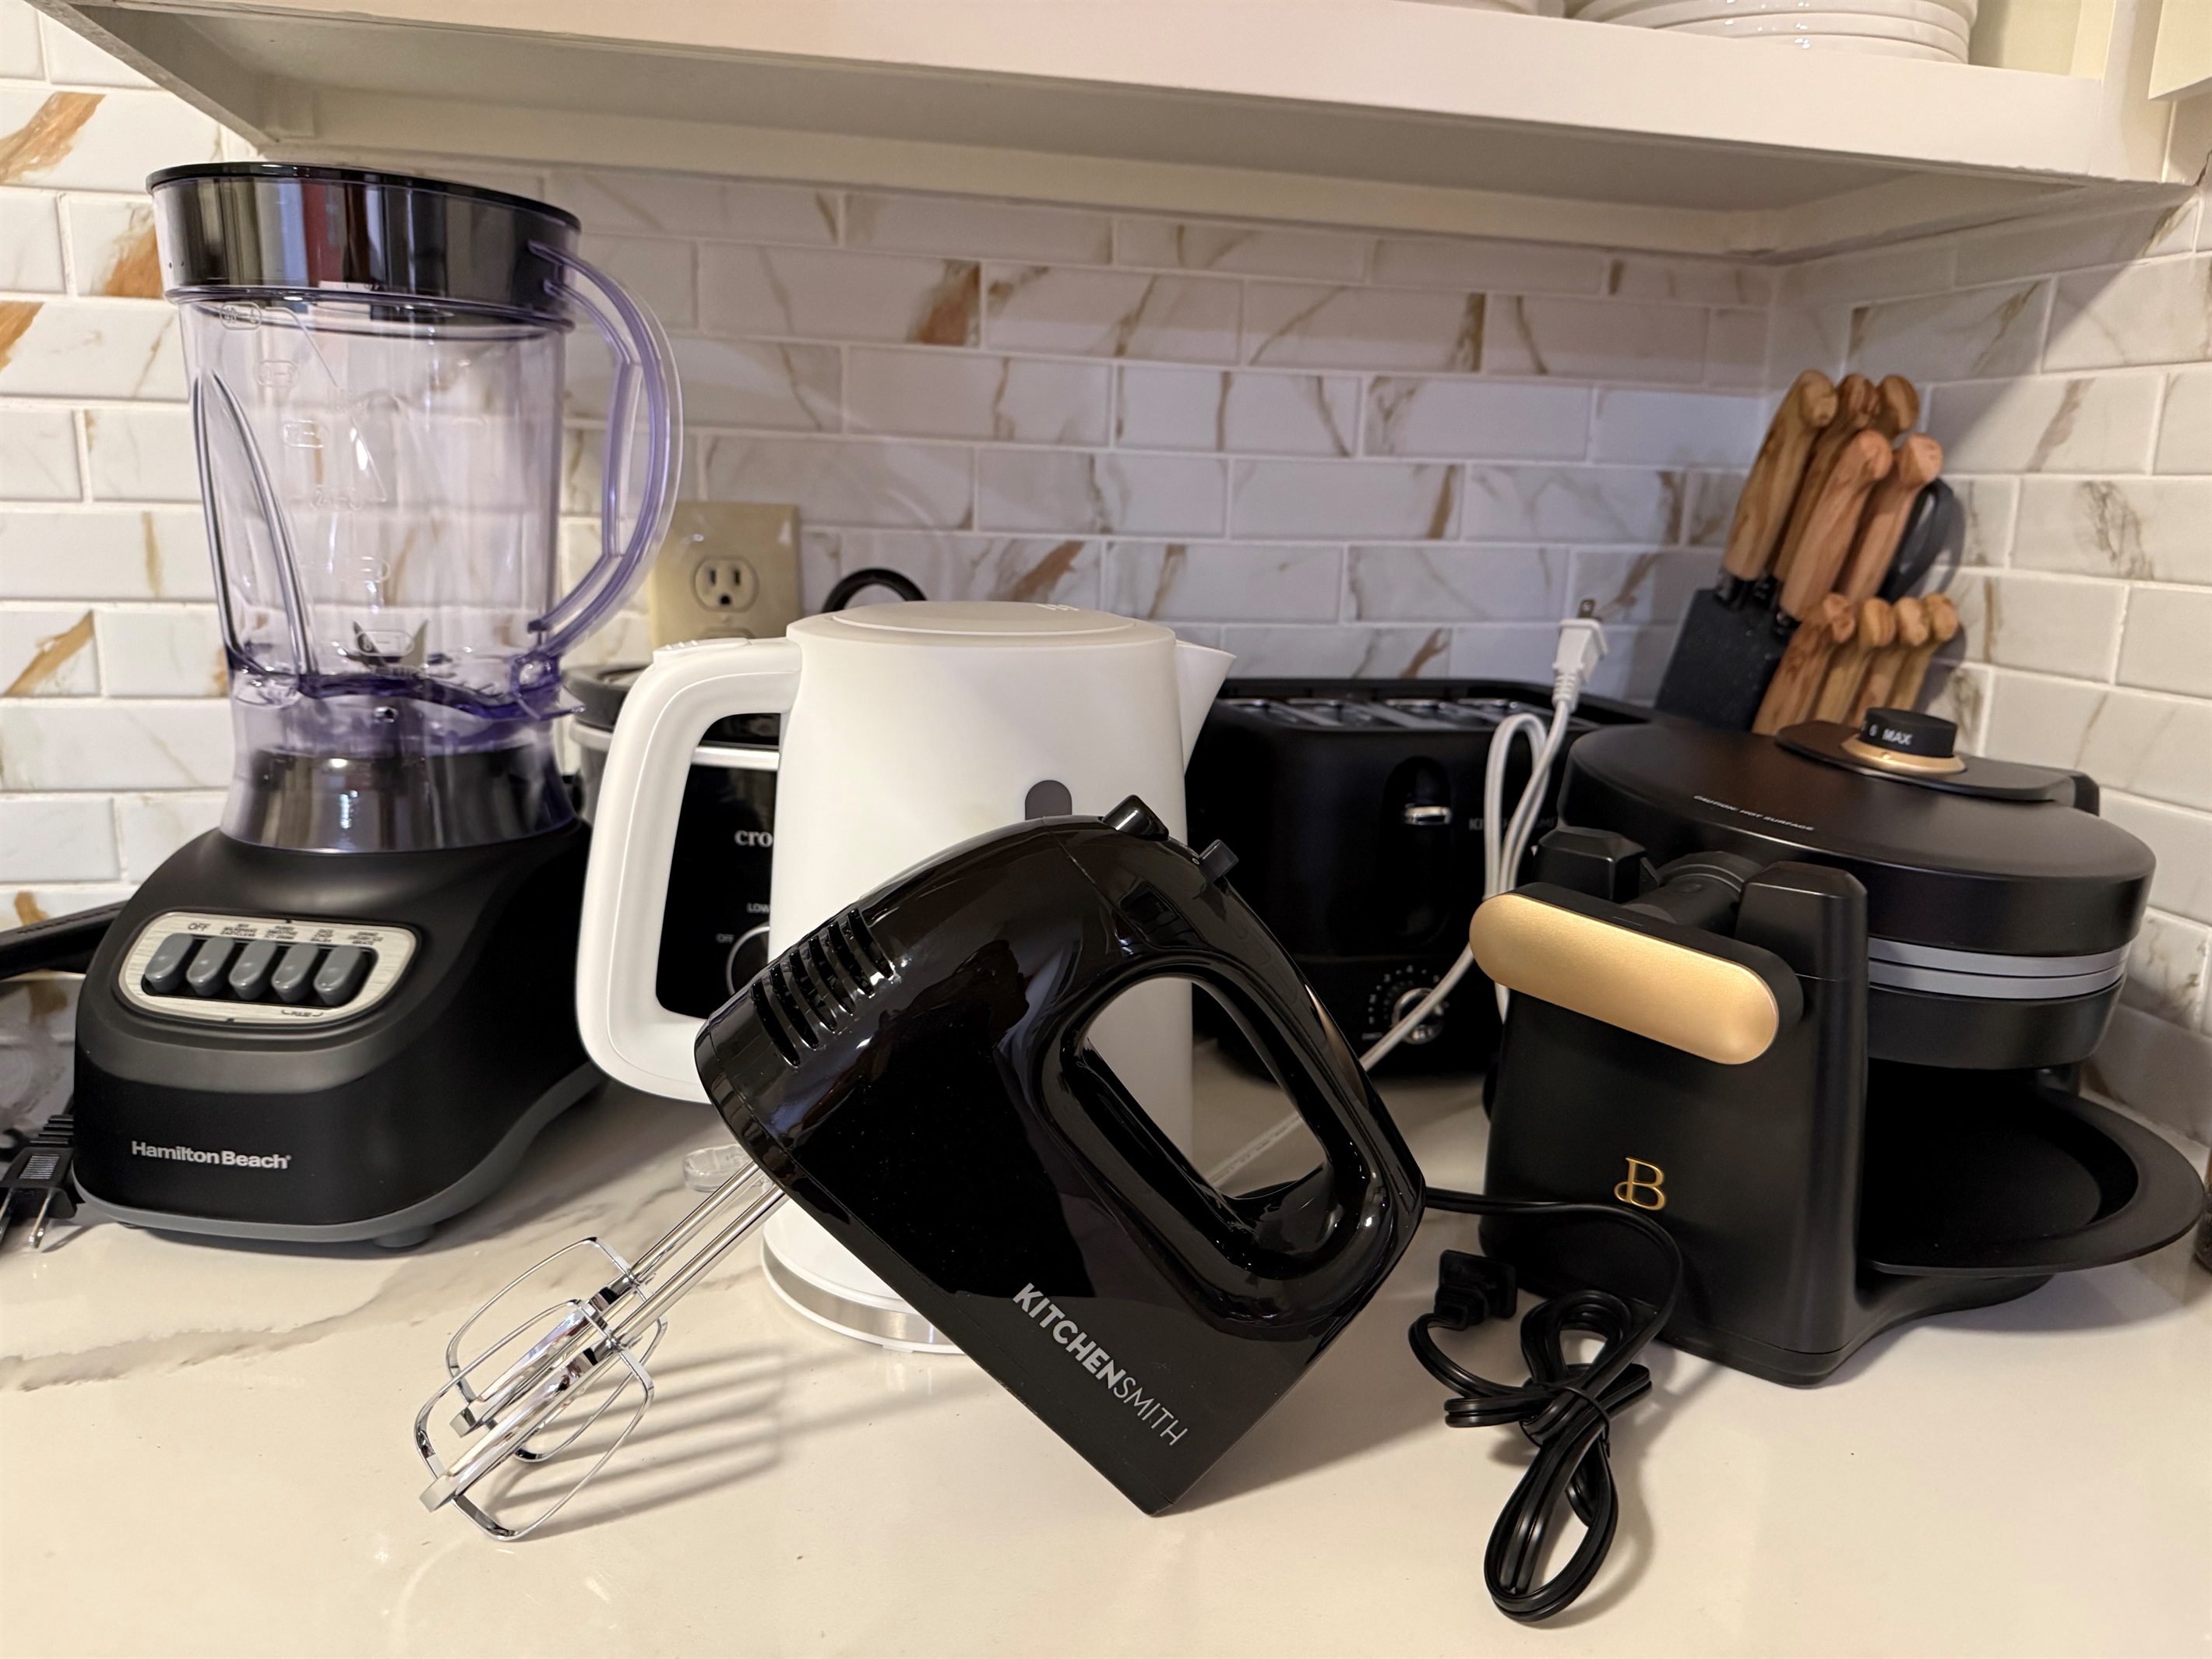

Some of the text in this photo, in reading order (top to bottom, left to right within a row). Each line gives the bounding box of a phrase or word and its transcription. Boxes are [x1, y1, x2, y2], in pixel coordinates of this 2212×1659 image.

[1882, 728, 1914, 745] MAX
[1739, 809, 1764, 819] HOT
[1763, 816, 1816, 831] SURFACE
[188, 922, 211, 932] OFF
[131, 1139, 220, 1164] Hamilton
[1613, 1156, 1665, 1211] B
[1012, 1282, 1189, 1446] KITCHENSMITH
